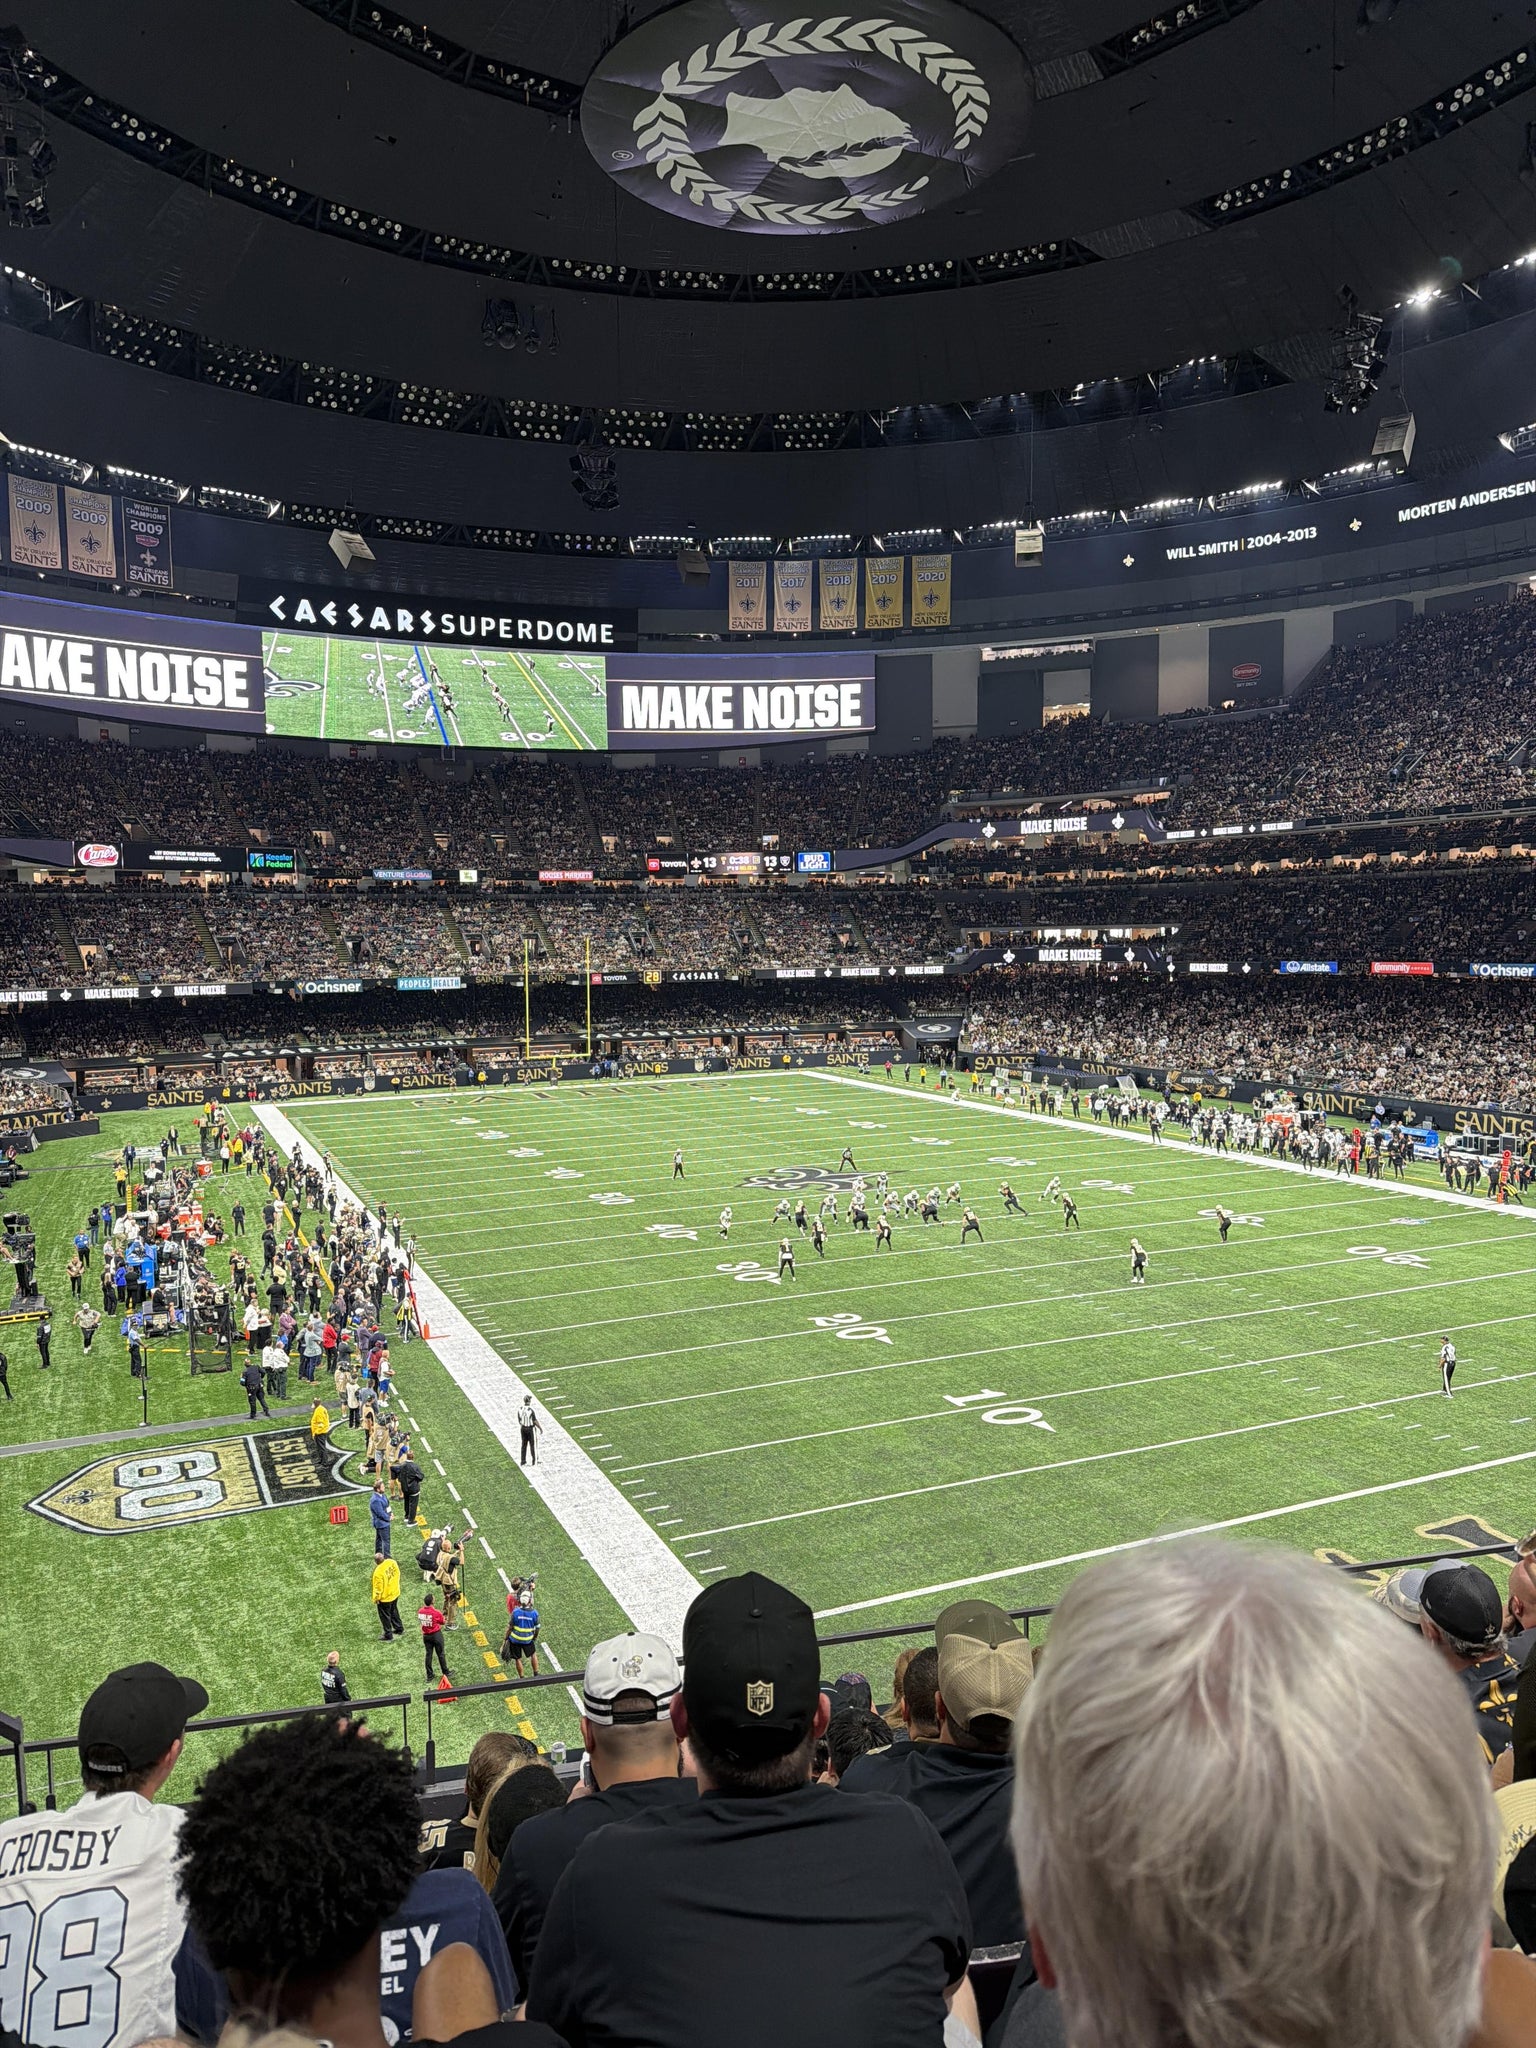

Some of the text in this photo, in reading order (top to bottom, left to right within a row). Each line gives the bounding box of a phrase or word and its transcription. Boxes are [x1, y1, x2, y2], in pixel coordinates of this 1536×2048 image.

[16, 497, 53, 515] 2009
[1397, 480, 1536, 523] MORTEN ANDERSEN
[125, 507, 167, 521] CHAMPIONS
[133, 503, 159, 514] WORLD
[71, 508, 107, 526] 2009
[130, 519, 164, 535] 2009
[1166, 526, 1318, 561] WILL SMITH 2004-2013
[14, 551, 58, 567] SAINTS
[72, 560, 113, 576] SAINTS
[129, 564, 143, 573] NEW
[129, 570, 169, 586] SAINTS
[735, 578, 759, 588] 2011
[780, 578, 807, 588] 2017
[826, 575, 851, 586] 2018
[871, 574, 897, 584] 2019
[917, 572, 946, 582] 2020
[268, 595, 615, 645] CAESARS SUPERDOME
[731, 619, 764, 629] SAINTS
[776, 621, 809, 630] SAINTS
[822, 618, 855, 628] SAINTS
[867, 618, 901, 627] SAINTS
[914, 616, 948, 626] SAINTS
[1, 634, 249, 709] AKE NOISE
[622, 683, 862, 730] MAKE NOISE
[1020, 816, 1088, 834] MAKE NOISE
[265, 853, 293, 862] Keesler
[703, 857, 717, 868] 13
[763, 856, 778, 867] 13
[803, 854, 824, 863] BUD
[265, 861, 293, 869] Federal
[661, 860, 687, 868] TOYOTA
[800, 860, 830, 870] LIGHT
[1039, 949, 1101, 961] MAKE NOISE
[1300, 963, 1331, 972] Allstate
[1374, 962, 1411, 974] Community
[1479, 964, 1535, 977] Ochsner
[476, 975, 504, 984] SAINTS
[538, 974, 566, 983] SAINTS
[603, 974, 628, 982] TOYOTA
[645, 971, 660, 982] 28
[672, 972, 720, 981] CAESARS
[305, 980, 362, 994] Ochsner
[399, 978, 461, 988] PEOPLES HEALTH
[18, 990, 48, 1001] NOISE
[84, 987, 139, 999] MAKE NOISE
[174, 984, 226, 996] MAKE NOISE
[686, 1025, 800, 1036] SUPERDOME
[334, 1039, 467, 1051] SUPERDOME
[730, 1057, 771, 1069] SAINTS
[827, 1053, 869, 1064] SAINTS
[975, 1056, 1035, 1071] SAINTS
[517, 1067, 563, 1081] SAINTS
[625, 1062, 669, 1075] SAINTS
[402, 1073, 450, 1087] SAINTS
[279, 1081, 332, 1096] SAINTS
[148, 1090, 204, 1106] SAINTS
[1303, 1092, 1366, 1114] SAINTS
[1455, 1111, 1534, 1135] SAINTS
[716, 1261, 780, 1284] 30
[808, 1313, 888, 1342] 20
[942, 1388, 1044, 1425] 10
[274, 1459, 321, 1489] 1967
[116, 1452, 224, 1520] 60
[751, 1695, 769, 1712] NFL
[0, 1825, 122, 1879] CROSBY
